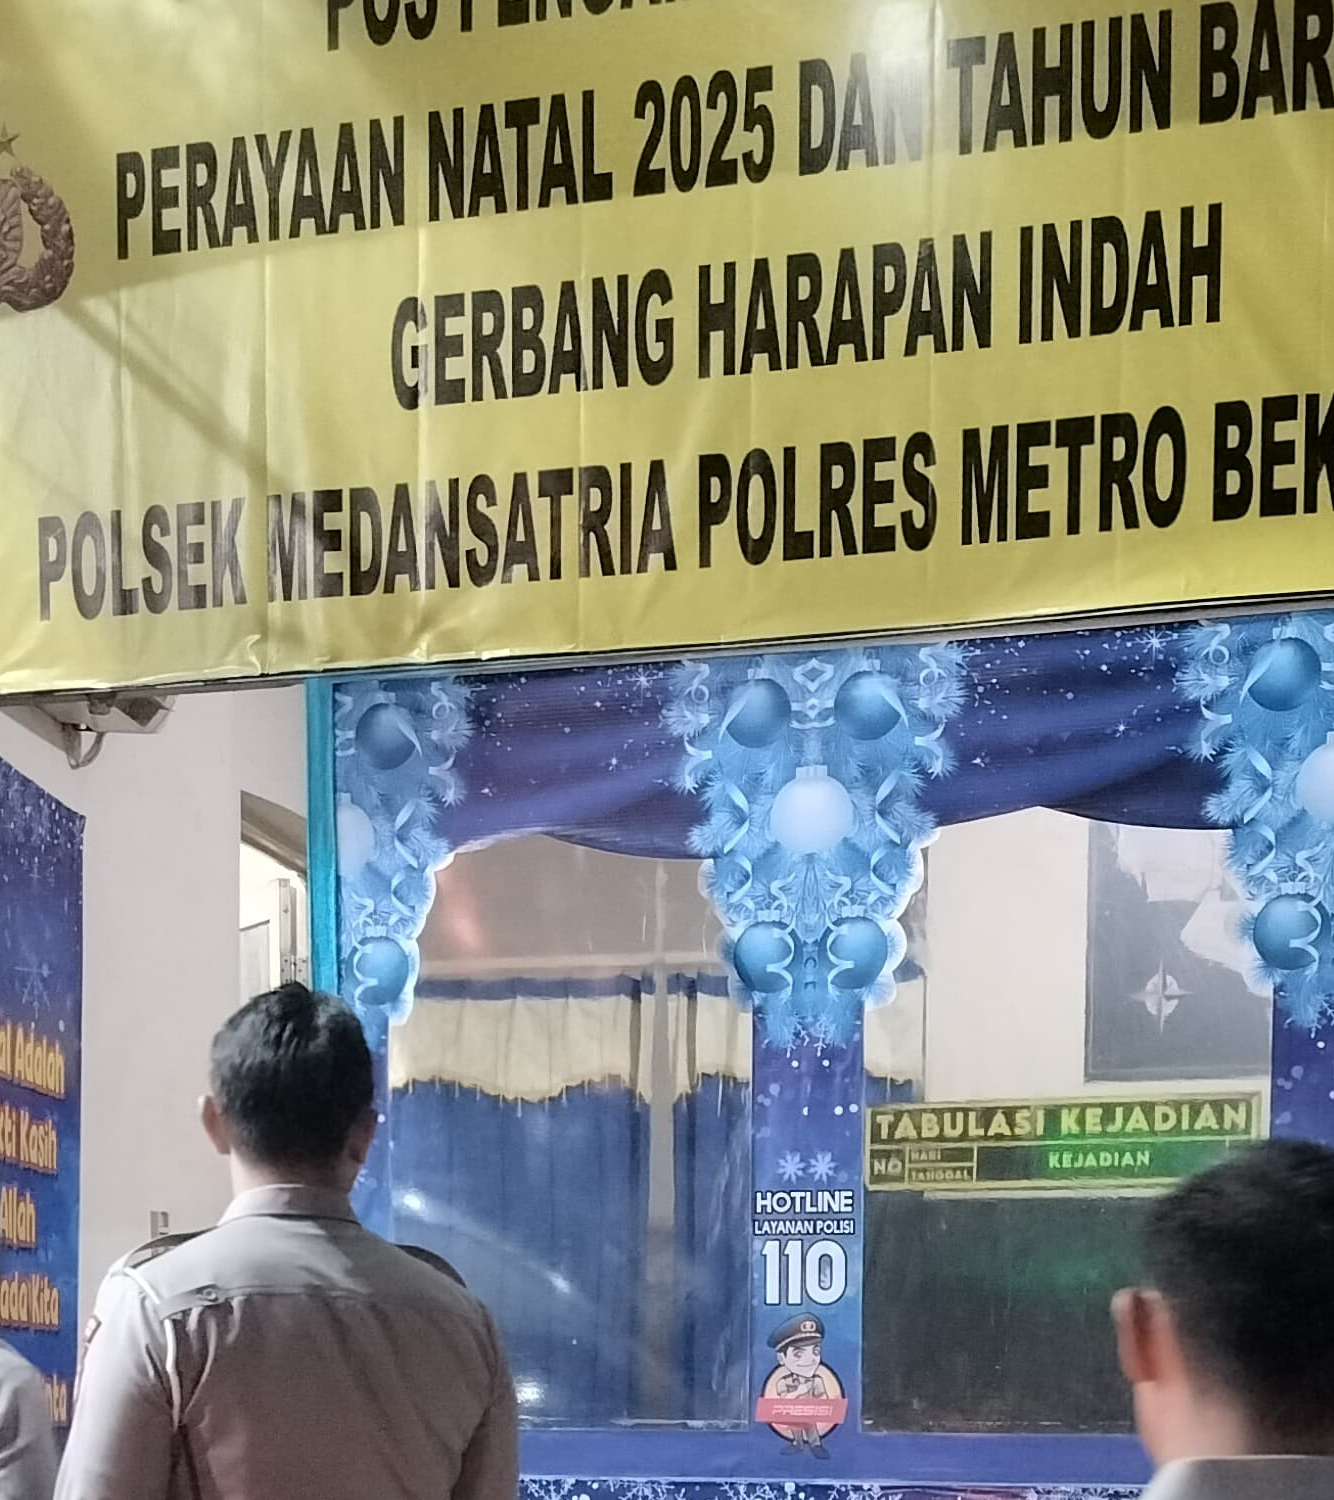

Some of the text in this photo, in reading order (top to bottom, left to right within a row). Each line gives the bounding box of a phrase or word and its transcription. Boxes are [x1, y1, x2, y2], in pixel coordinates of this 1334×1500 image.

[116, 112, 405, 261] PERAYAAN
[427, 88, 613, 222] NATAL
[633, 65, 775, 198] 2025
[799, 47, 923, 176] DAN
[947, 9, 1172, 155] TAHUN
[391, 202, 1223, 411] GERBANG HARAPAN INDAH
[39, 496, 247, 621] POLSEK
[267, 458, 677, 603] MEDANSATRIA
[699, 430, 936, 569] POLRES
[961, 405, 1187, 548] METRO
[15, 1025, 65, 1094] Adalah
[19, 1110, 57, 1169] Kasih
[875, 1101, 1247, 1141] TABULASI KEJADIAN
[873, 1150, 1150, 1177] NO KEJADIAN
[0, 1186, 36, 1243] Allah
[754, 1219, 855, 1234] LAYANAN POLISI
[755, 1190, 853, 1213] HOTLINE
[762, 1239, 847, 1305] 110
[30, 1274, 60, 1326] Kita
[43, 1374, 68, 1422] nta
[771, 1404, 835, 1417] PRESISI
